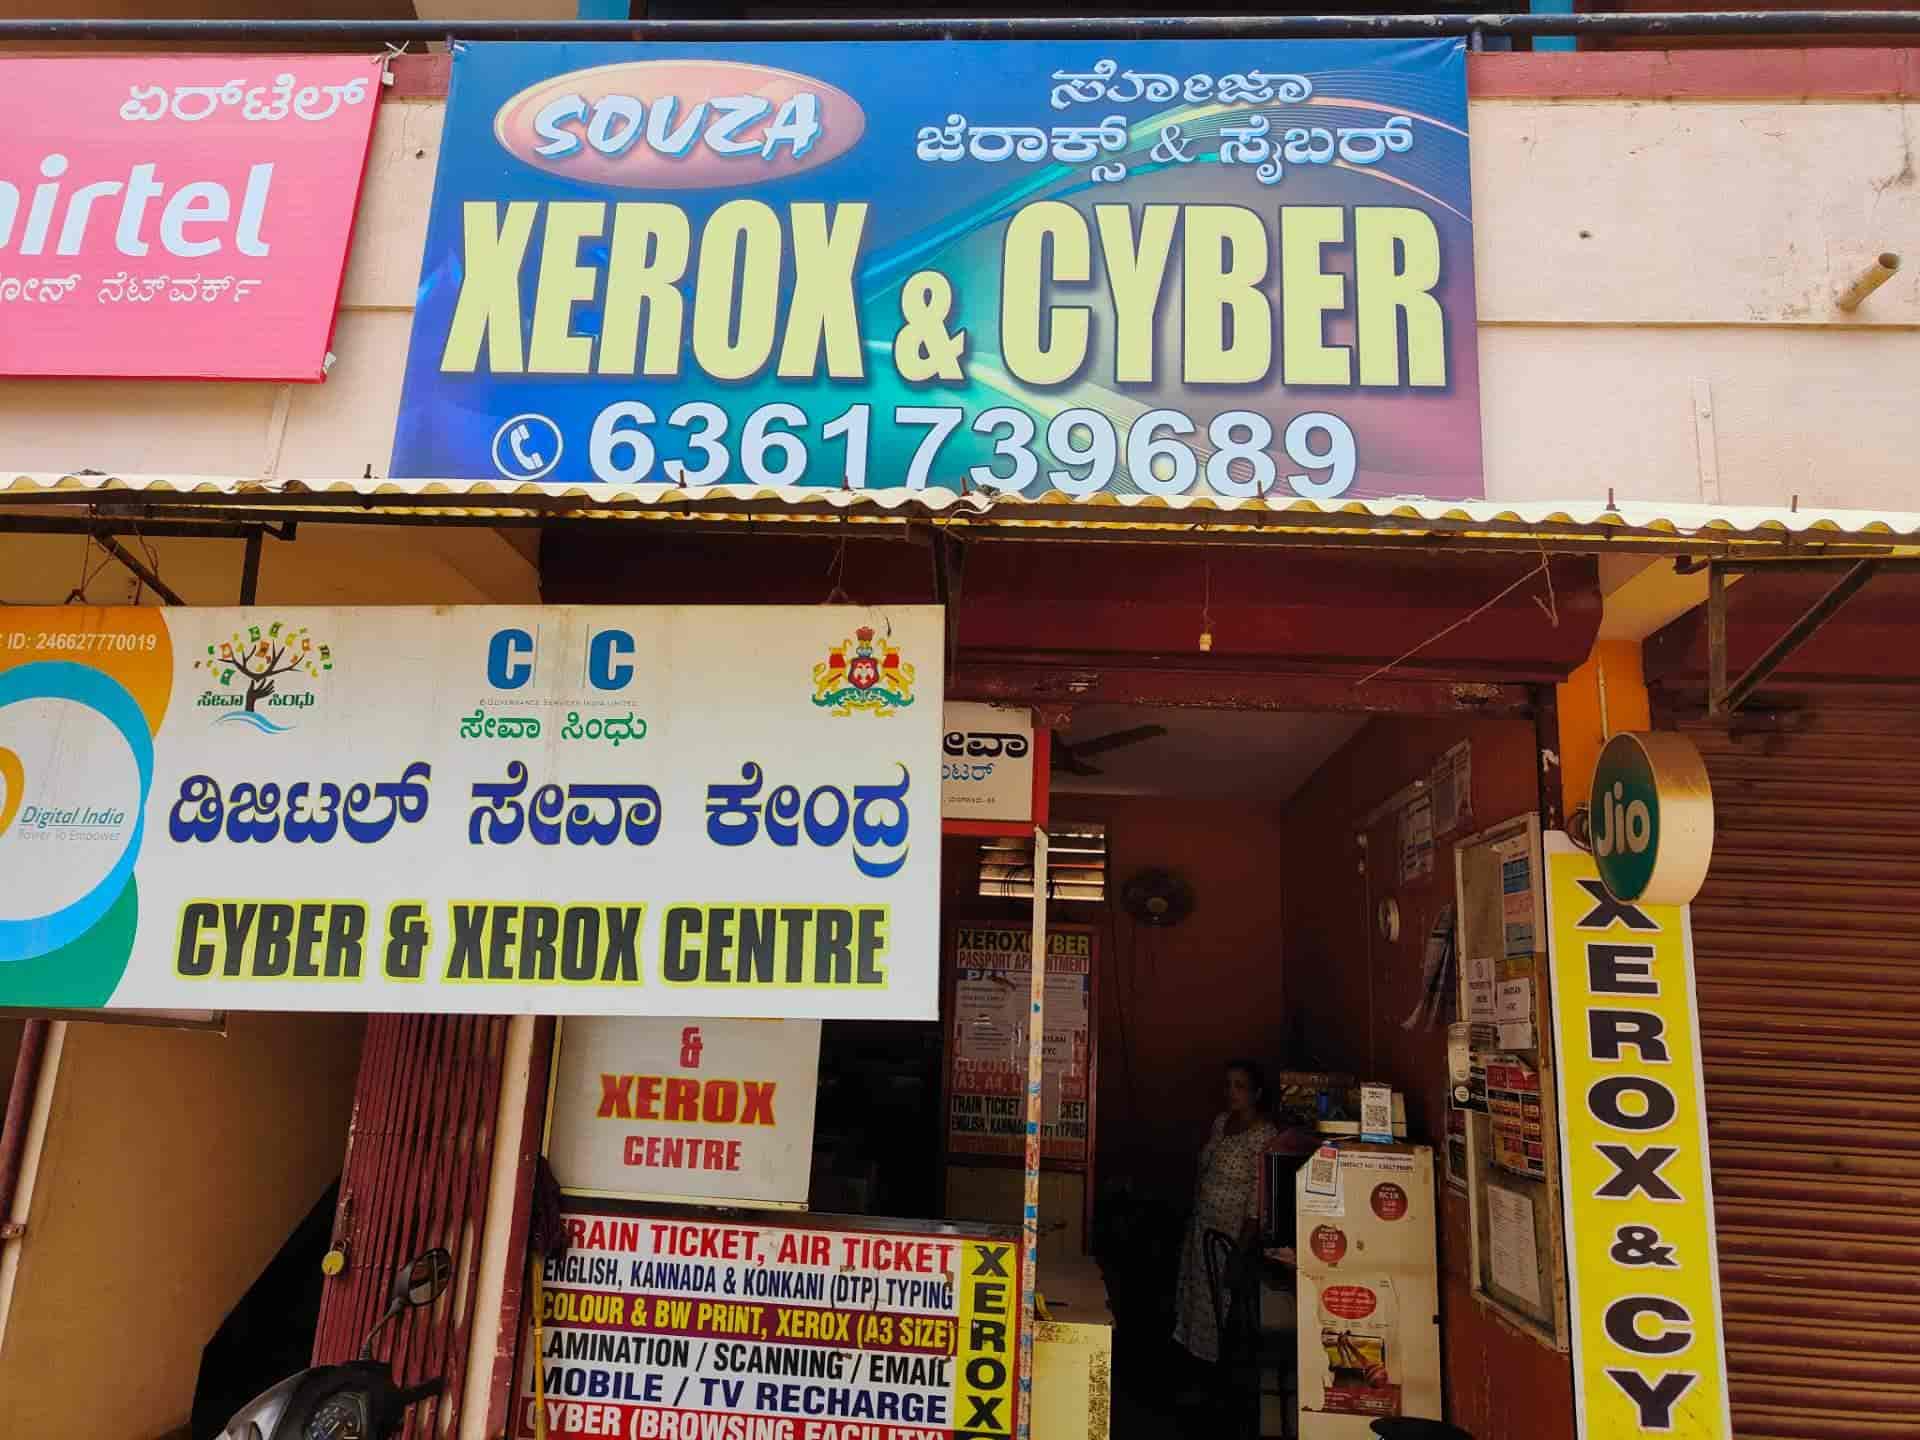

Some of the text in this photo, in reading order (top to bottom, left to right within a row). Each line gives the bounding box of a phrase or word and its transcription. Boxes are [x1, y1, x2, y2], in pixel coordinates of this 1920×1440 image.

[534, 94, 822, 161] SOUZA
[1150, 123, 1195, 164] &
[1219, 115, 1415, 184] ಸೈಬರ್
[440, 199, 1447, 387] XEROX & CYBER
[588, 400, 1359, 498] 6361739689
[8, 632, 32, 650] ID:
[36, 632, 158, 651] 246627770019
[459, 709, 648, 747] ಸೇವಾ ಸಿಂಧು
[21, 805, 125, 829] Digital India
[168, 760, 911, 880] ಡಿಜಿಟಲ್ ಸೇವಾ ಕೇಂದ್ರ
[1596, 781, 1651, 857] Jio
[176, 902, 887, 985] CYBER & XEROX CENTRE
[959, 929, 1025, 952] XEROX
[679, 1026, 703, 1069] &
[1575, 878, 1684, 1201] XEROX
[597, 1073, 777, 1127] XEROX
[623, 1135, 742, 1172] CENTRE
[650, 1223, 766, 1266] TICKET,
[777, 1233, 831, 1267] AIR
[842, 1237, 954, 1275] TICKET
[1609, 1225, 1679, 1267] &
[543, 1256, 953, 1312] ENGLISH, KANNADA & KONKANI (DTP) TYPING
[631, 1297, 647, 1327] &
[655, 1299, 693, 1330] BW
[776, 1309, 850, 1342] XEROX
[857, 1314, 894, 1349] (A3
[964, 1244, 1010, 1430] XEROX
[542, 1330, 690, 1368] AMINATION
[695, 1342, 708, 1372] /
[713, 1342, 843, 1380] SCANNING
[850, 1353, 863, 1384] /
[531, 1366, 947, 1424] MOBILE / TV RECHARGE
